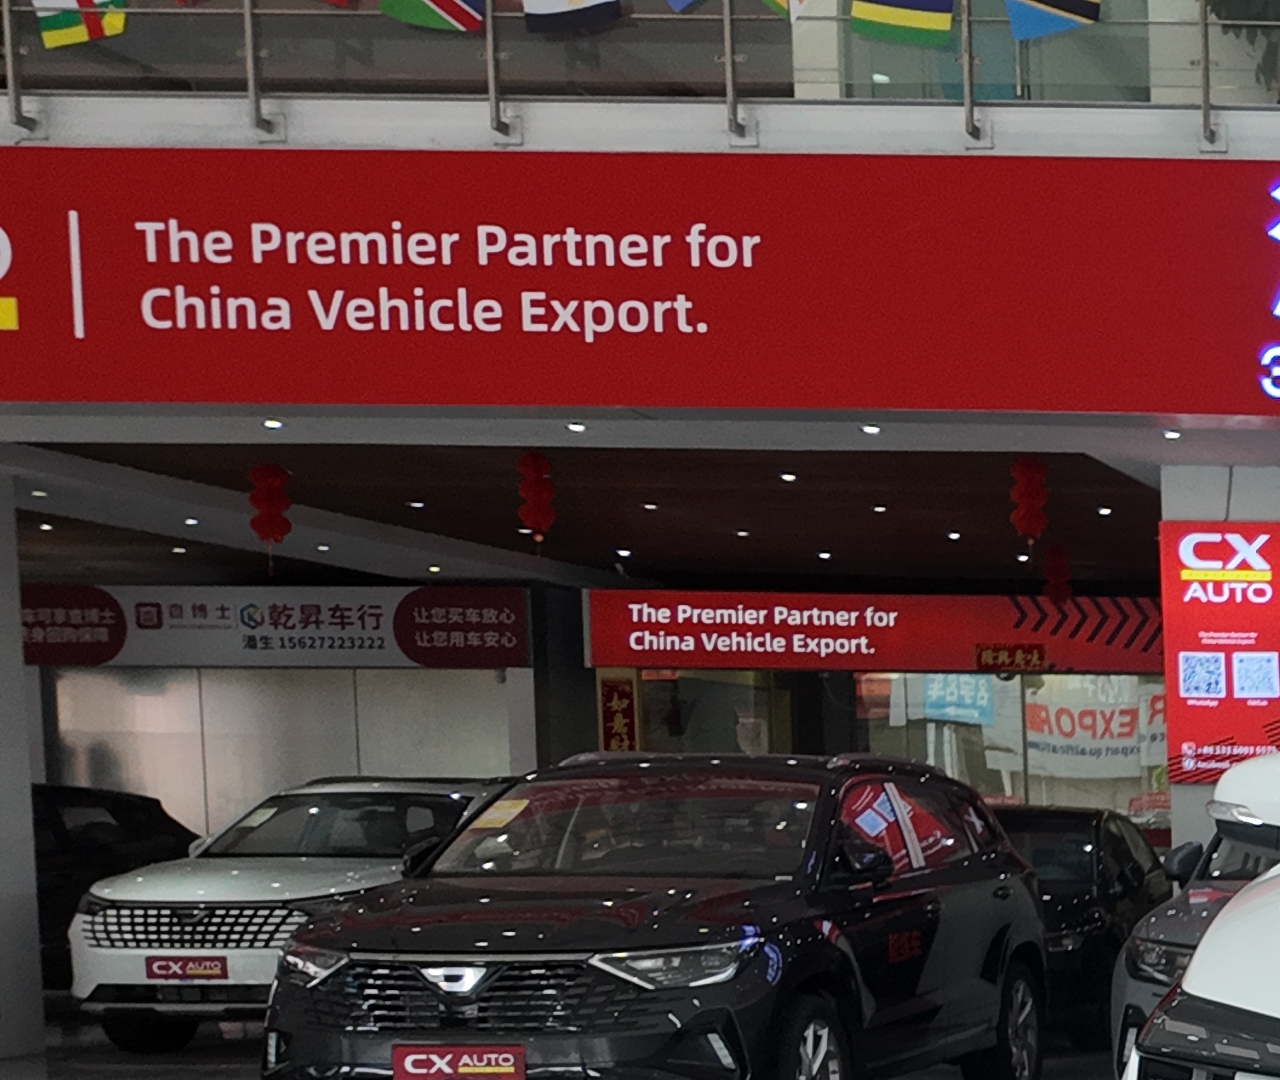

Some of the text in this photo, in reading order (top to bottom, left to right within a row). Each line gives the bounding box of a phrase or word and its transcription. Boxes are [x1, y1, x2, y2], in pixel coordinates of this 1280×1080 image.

[135, 219, 760, 267] The Premier Partner for
[141, 285, 707, 343] China Vehicle Export.
[1178, 532, 1271, 570] CX
[1183, 581, 1273, 604] AUTO
[628, 603, 898, 627] The Premier Partner for
[630, 631, 875, 657] China Vehicle Export.
[152, 961, 221, 975] CX AUTO
[404, 1053, 514, 1074] CX AUTO
